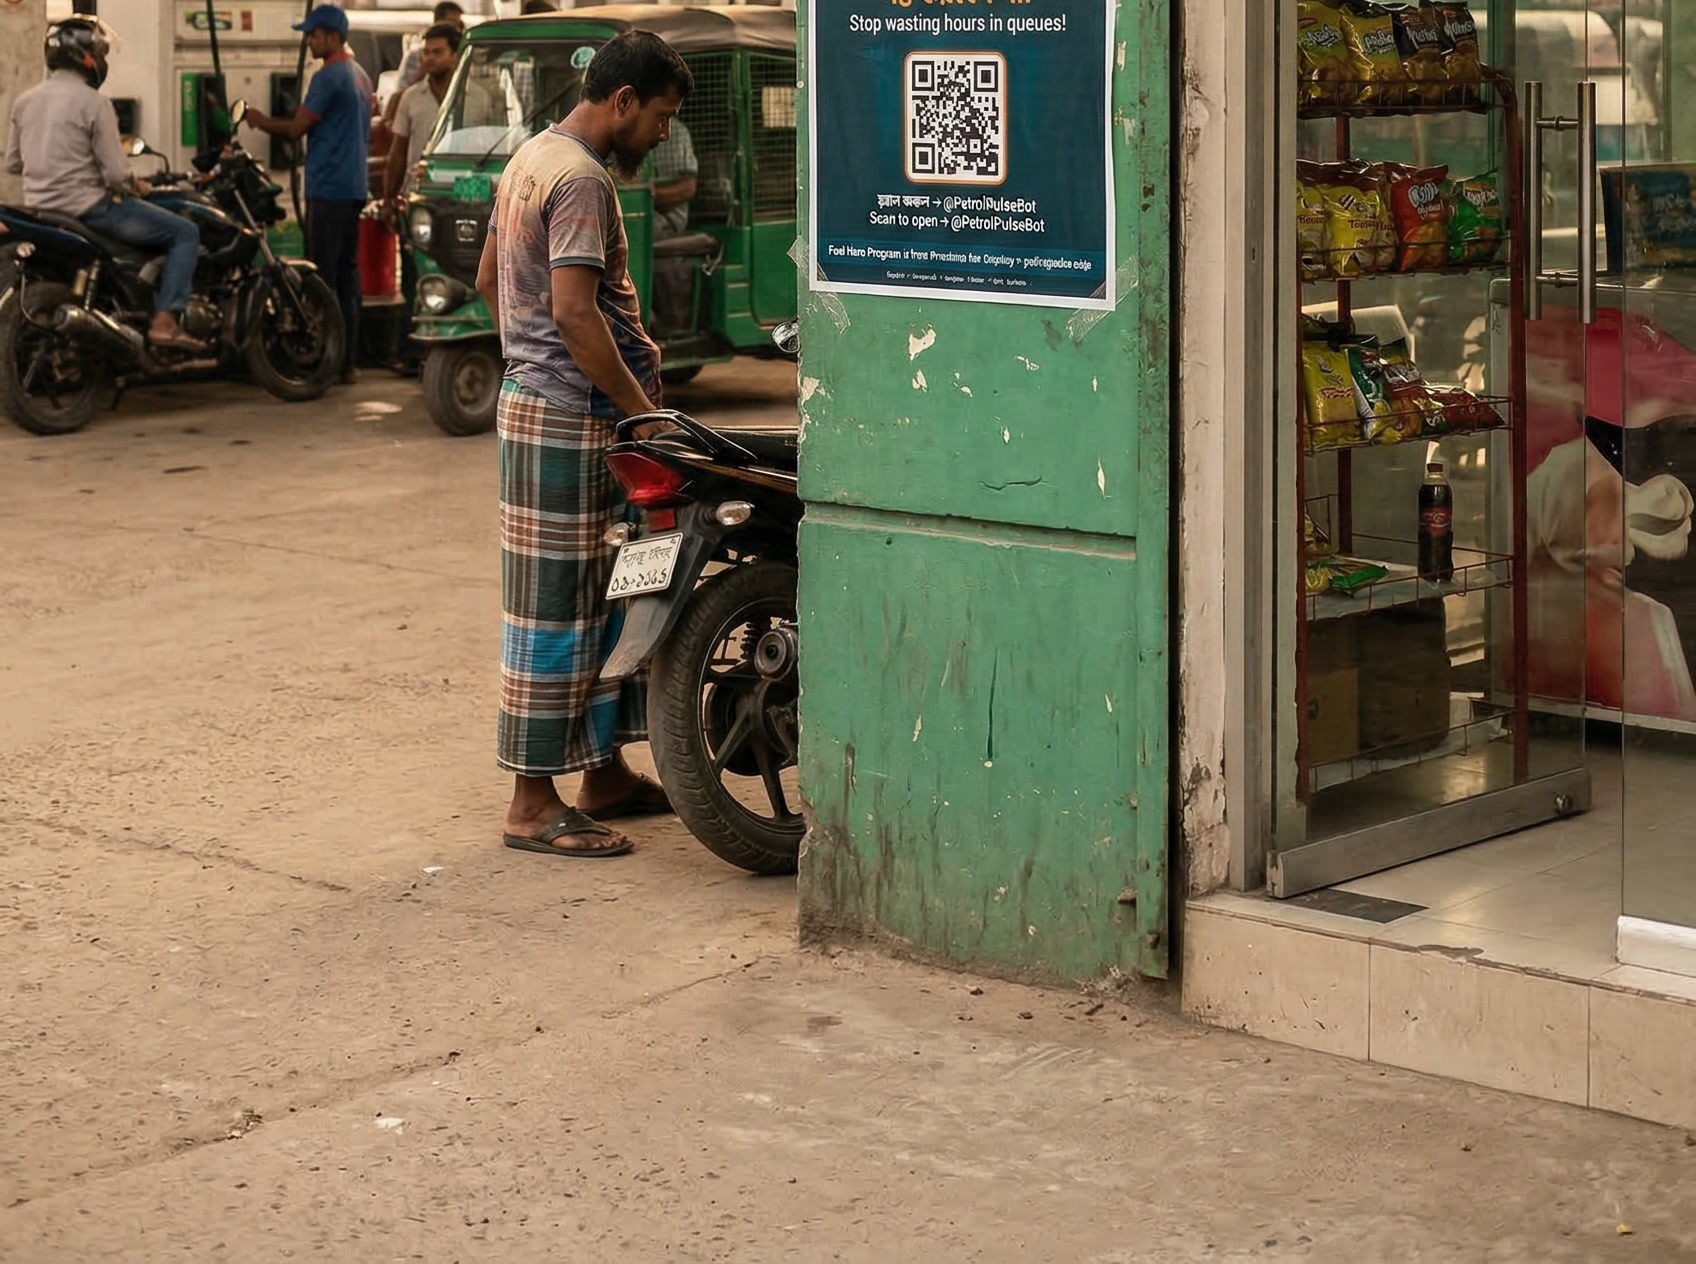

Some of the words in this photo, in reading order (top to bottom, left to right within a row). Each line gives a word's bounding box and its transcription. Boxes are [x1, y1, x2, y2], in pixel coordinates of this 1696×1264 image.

[849, 14, 881, 35] Stop
[885, 13, 940, 36] wasting
[944, 13, 985, 31] hours
[989, 13, 1003, 31] in
[1007, 13, 1066, 35] queues!
[869, 211, 895, 225] Scan
[898, 213, 909, 226] to
[911, 216, 938, 230] open
[951, 215, 1045, 232] @PetrolPulseBot
